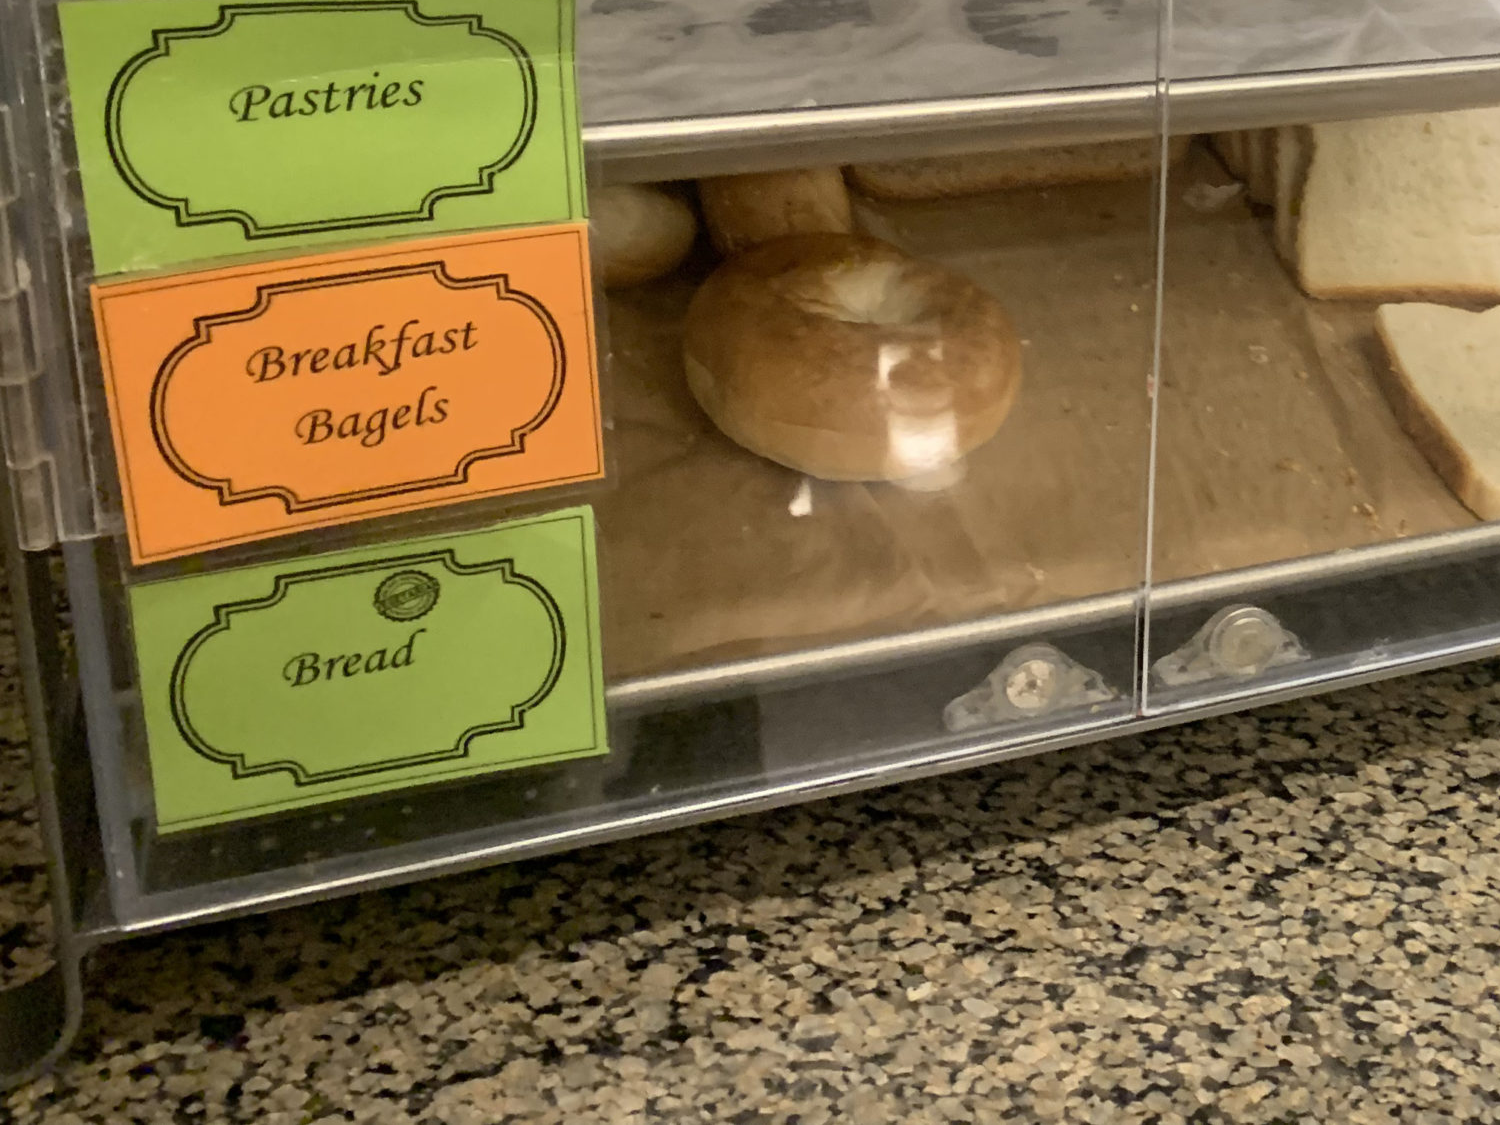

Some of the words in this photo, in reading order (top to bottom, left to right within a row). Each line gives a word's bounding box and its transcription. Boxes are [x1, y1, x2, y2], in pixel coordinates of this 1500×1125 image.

[229, 71, 425, 122] Pastries
[245, 319, 479, 384] Breakfast
[293, 386, 450, 447] Bagels
[282, 627, 427, 688] Bread
